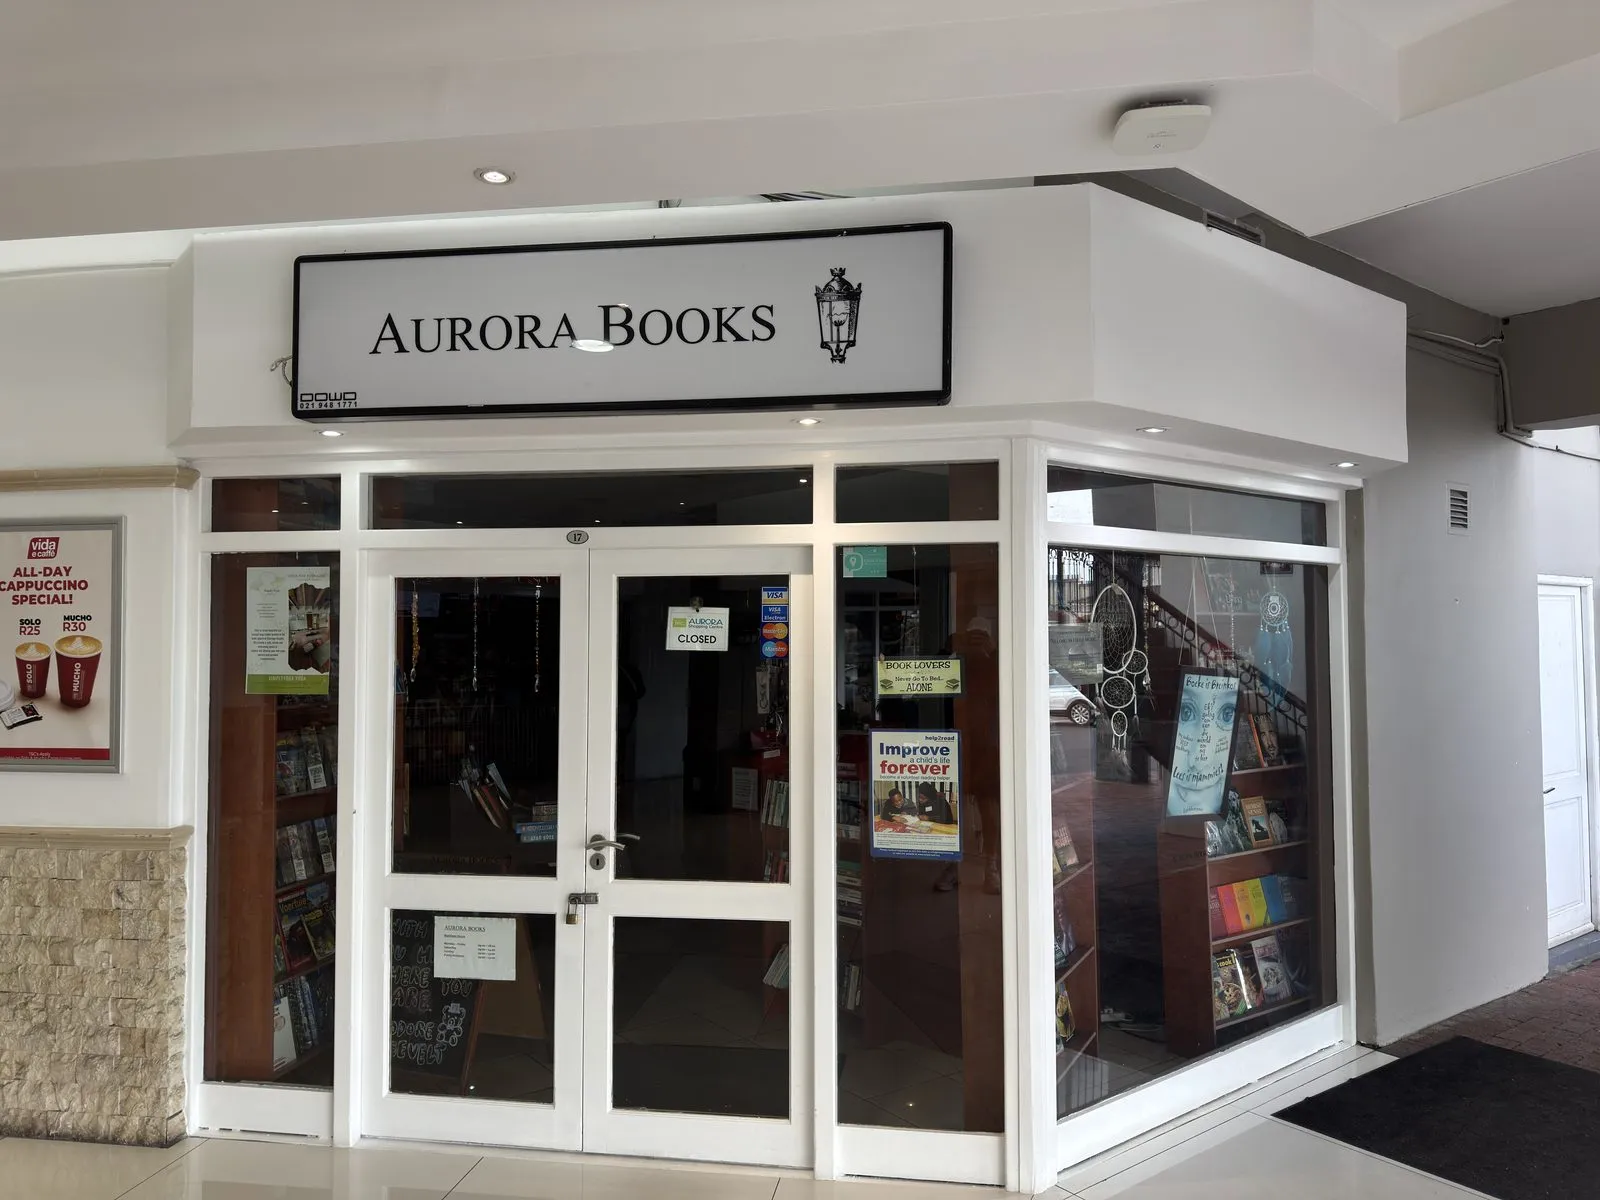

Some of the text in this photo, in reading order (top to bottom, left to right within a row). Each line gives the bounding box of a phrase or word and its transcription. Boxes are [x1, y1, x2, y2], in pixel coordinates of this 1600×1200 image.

[369, 303, 776, 354] AURORA BOOKS
[573, 533, 582, 541] 17
[31, 539, 56, 550] vida
[13, 566, 72, 577] ALL-DAY
[0, 580, 88, 591] CAPPUCCINO
[12, 594, 73, 605] SPECIAL!
[19, 625, 41, 635] R25
[62, 622, 86, 632] R30
[678, 634, 717, 644] CLOSED
[886, 661, 951, 669] BOOK LOVERS
[73, 662, 82, 692] MUCHO
[906, 682, 932, 692] ALONE
[879, 743, 950, 758] Improve
[880, 760, 950, 775] forever
